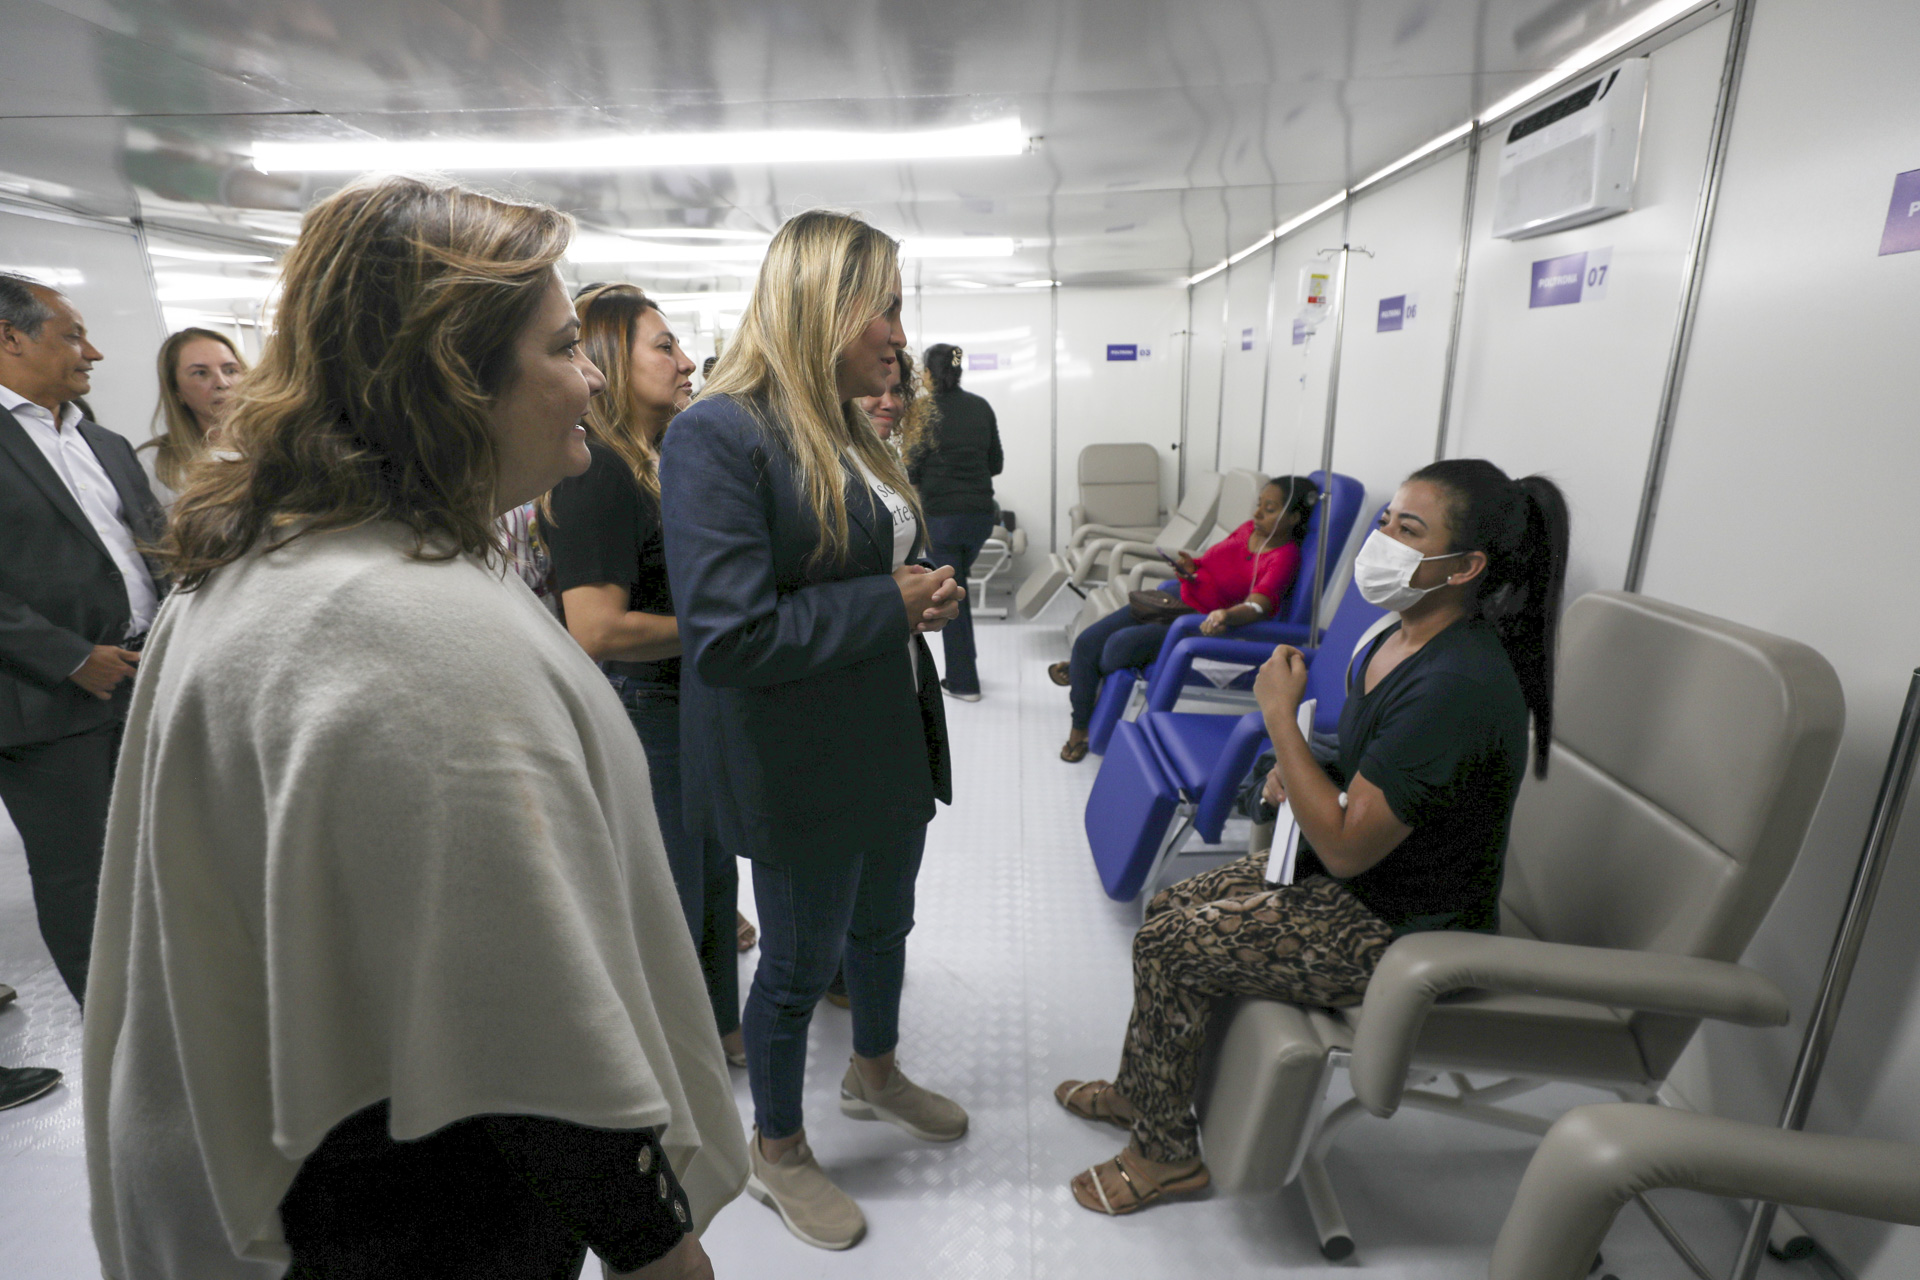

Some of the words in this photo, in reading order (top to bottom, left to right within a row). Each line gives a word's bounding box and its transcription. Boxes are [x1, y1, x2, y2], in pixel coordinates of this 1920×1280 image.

[1538, 273, 1578, 288] POLTRONA
[1587, 265, 1608, 287] 07
[1406, 304, 1417, 319] 06
